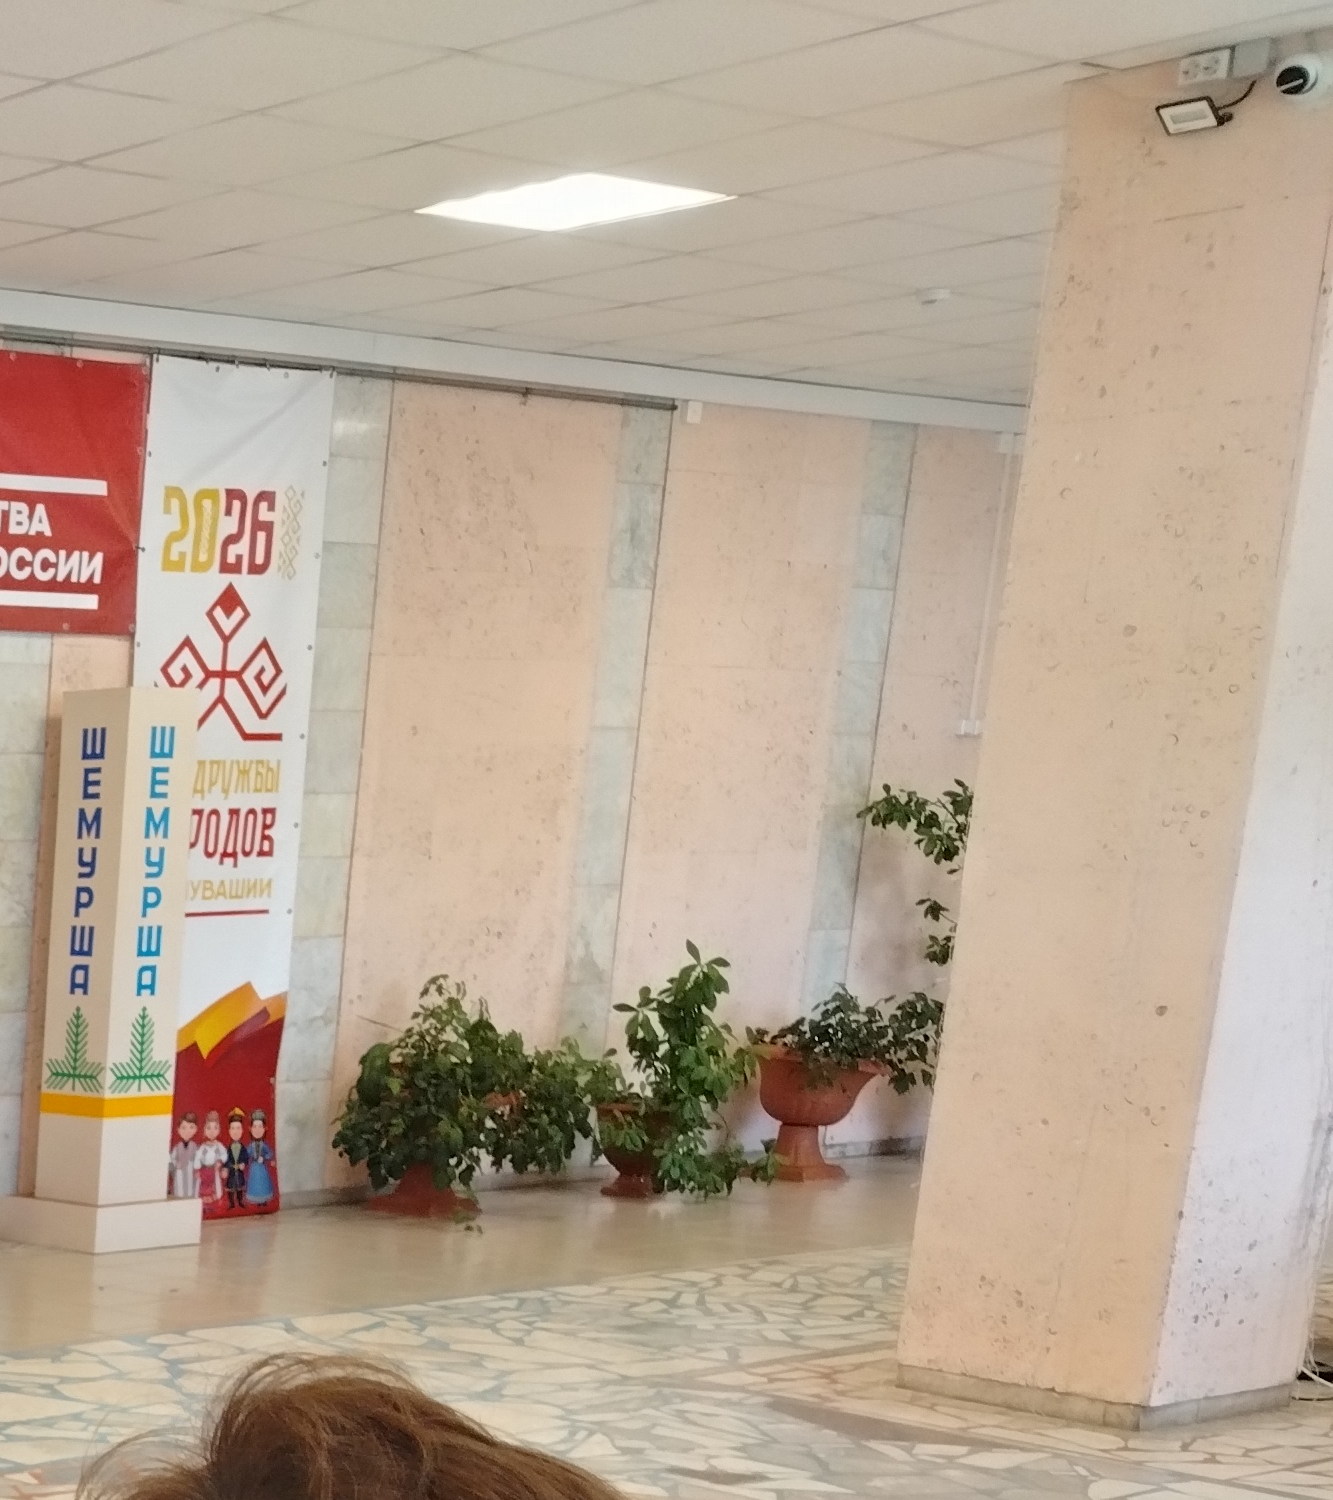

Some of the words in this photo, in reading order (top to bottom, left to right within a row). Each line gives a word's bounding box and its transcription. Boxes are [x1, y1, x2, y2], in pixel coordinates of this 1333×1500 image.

[161, 485, 276, 575] 2026
[192, 759, 281, 800] ДРУЖБЫ
[69, 727, 107, 995] ШЕМУРША
[136, 726, 175, 996] ШЕМУРША
[188, 878, 273, 901] УВАШИИ
